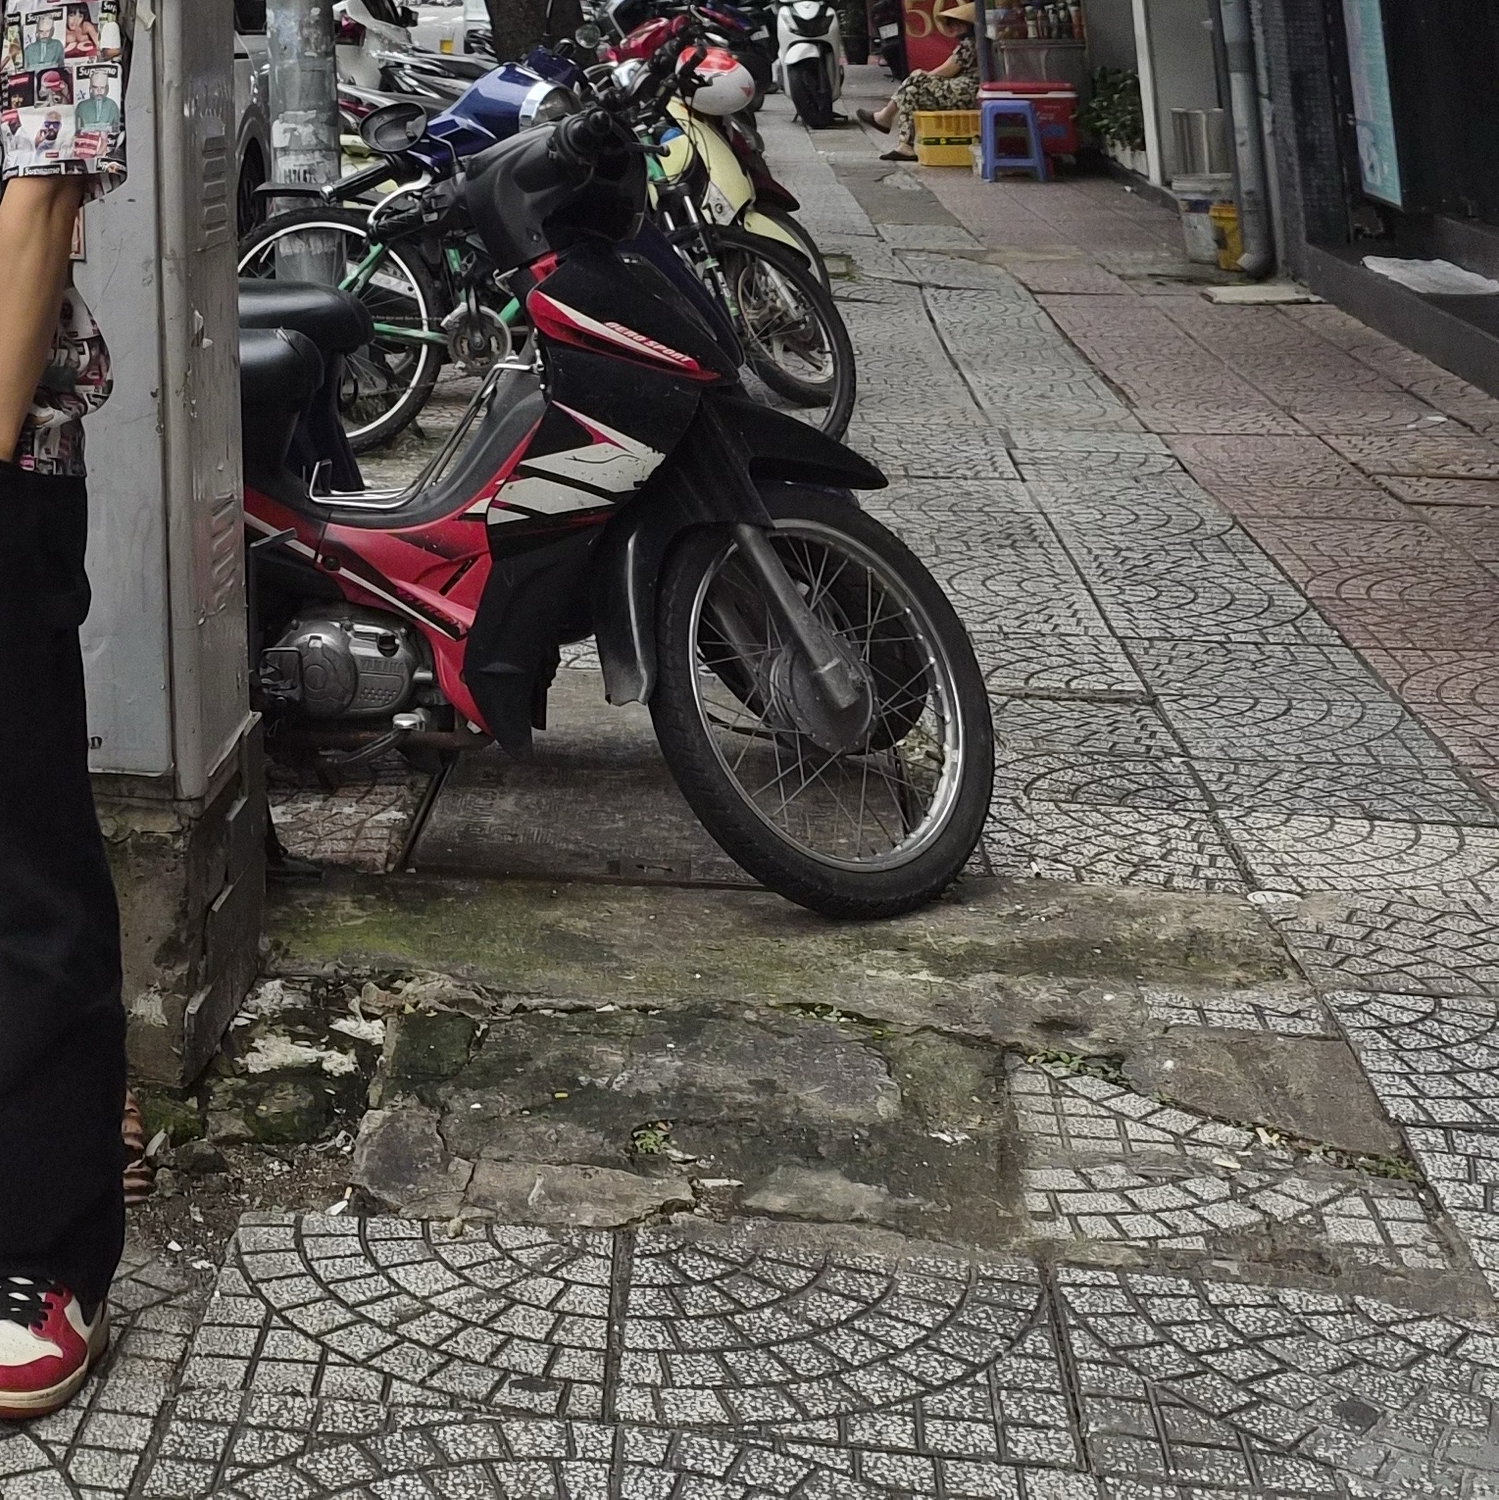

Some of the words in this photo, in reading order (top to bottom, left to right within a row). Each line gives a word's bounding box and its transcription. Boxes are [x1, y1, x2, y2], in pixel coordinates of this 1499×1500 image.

[26, 9, 62, 23] Supme
[78, 64, 118, 77] Supme
[644, 340, 693, 363] SPORT
